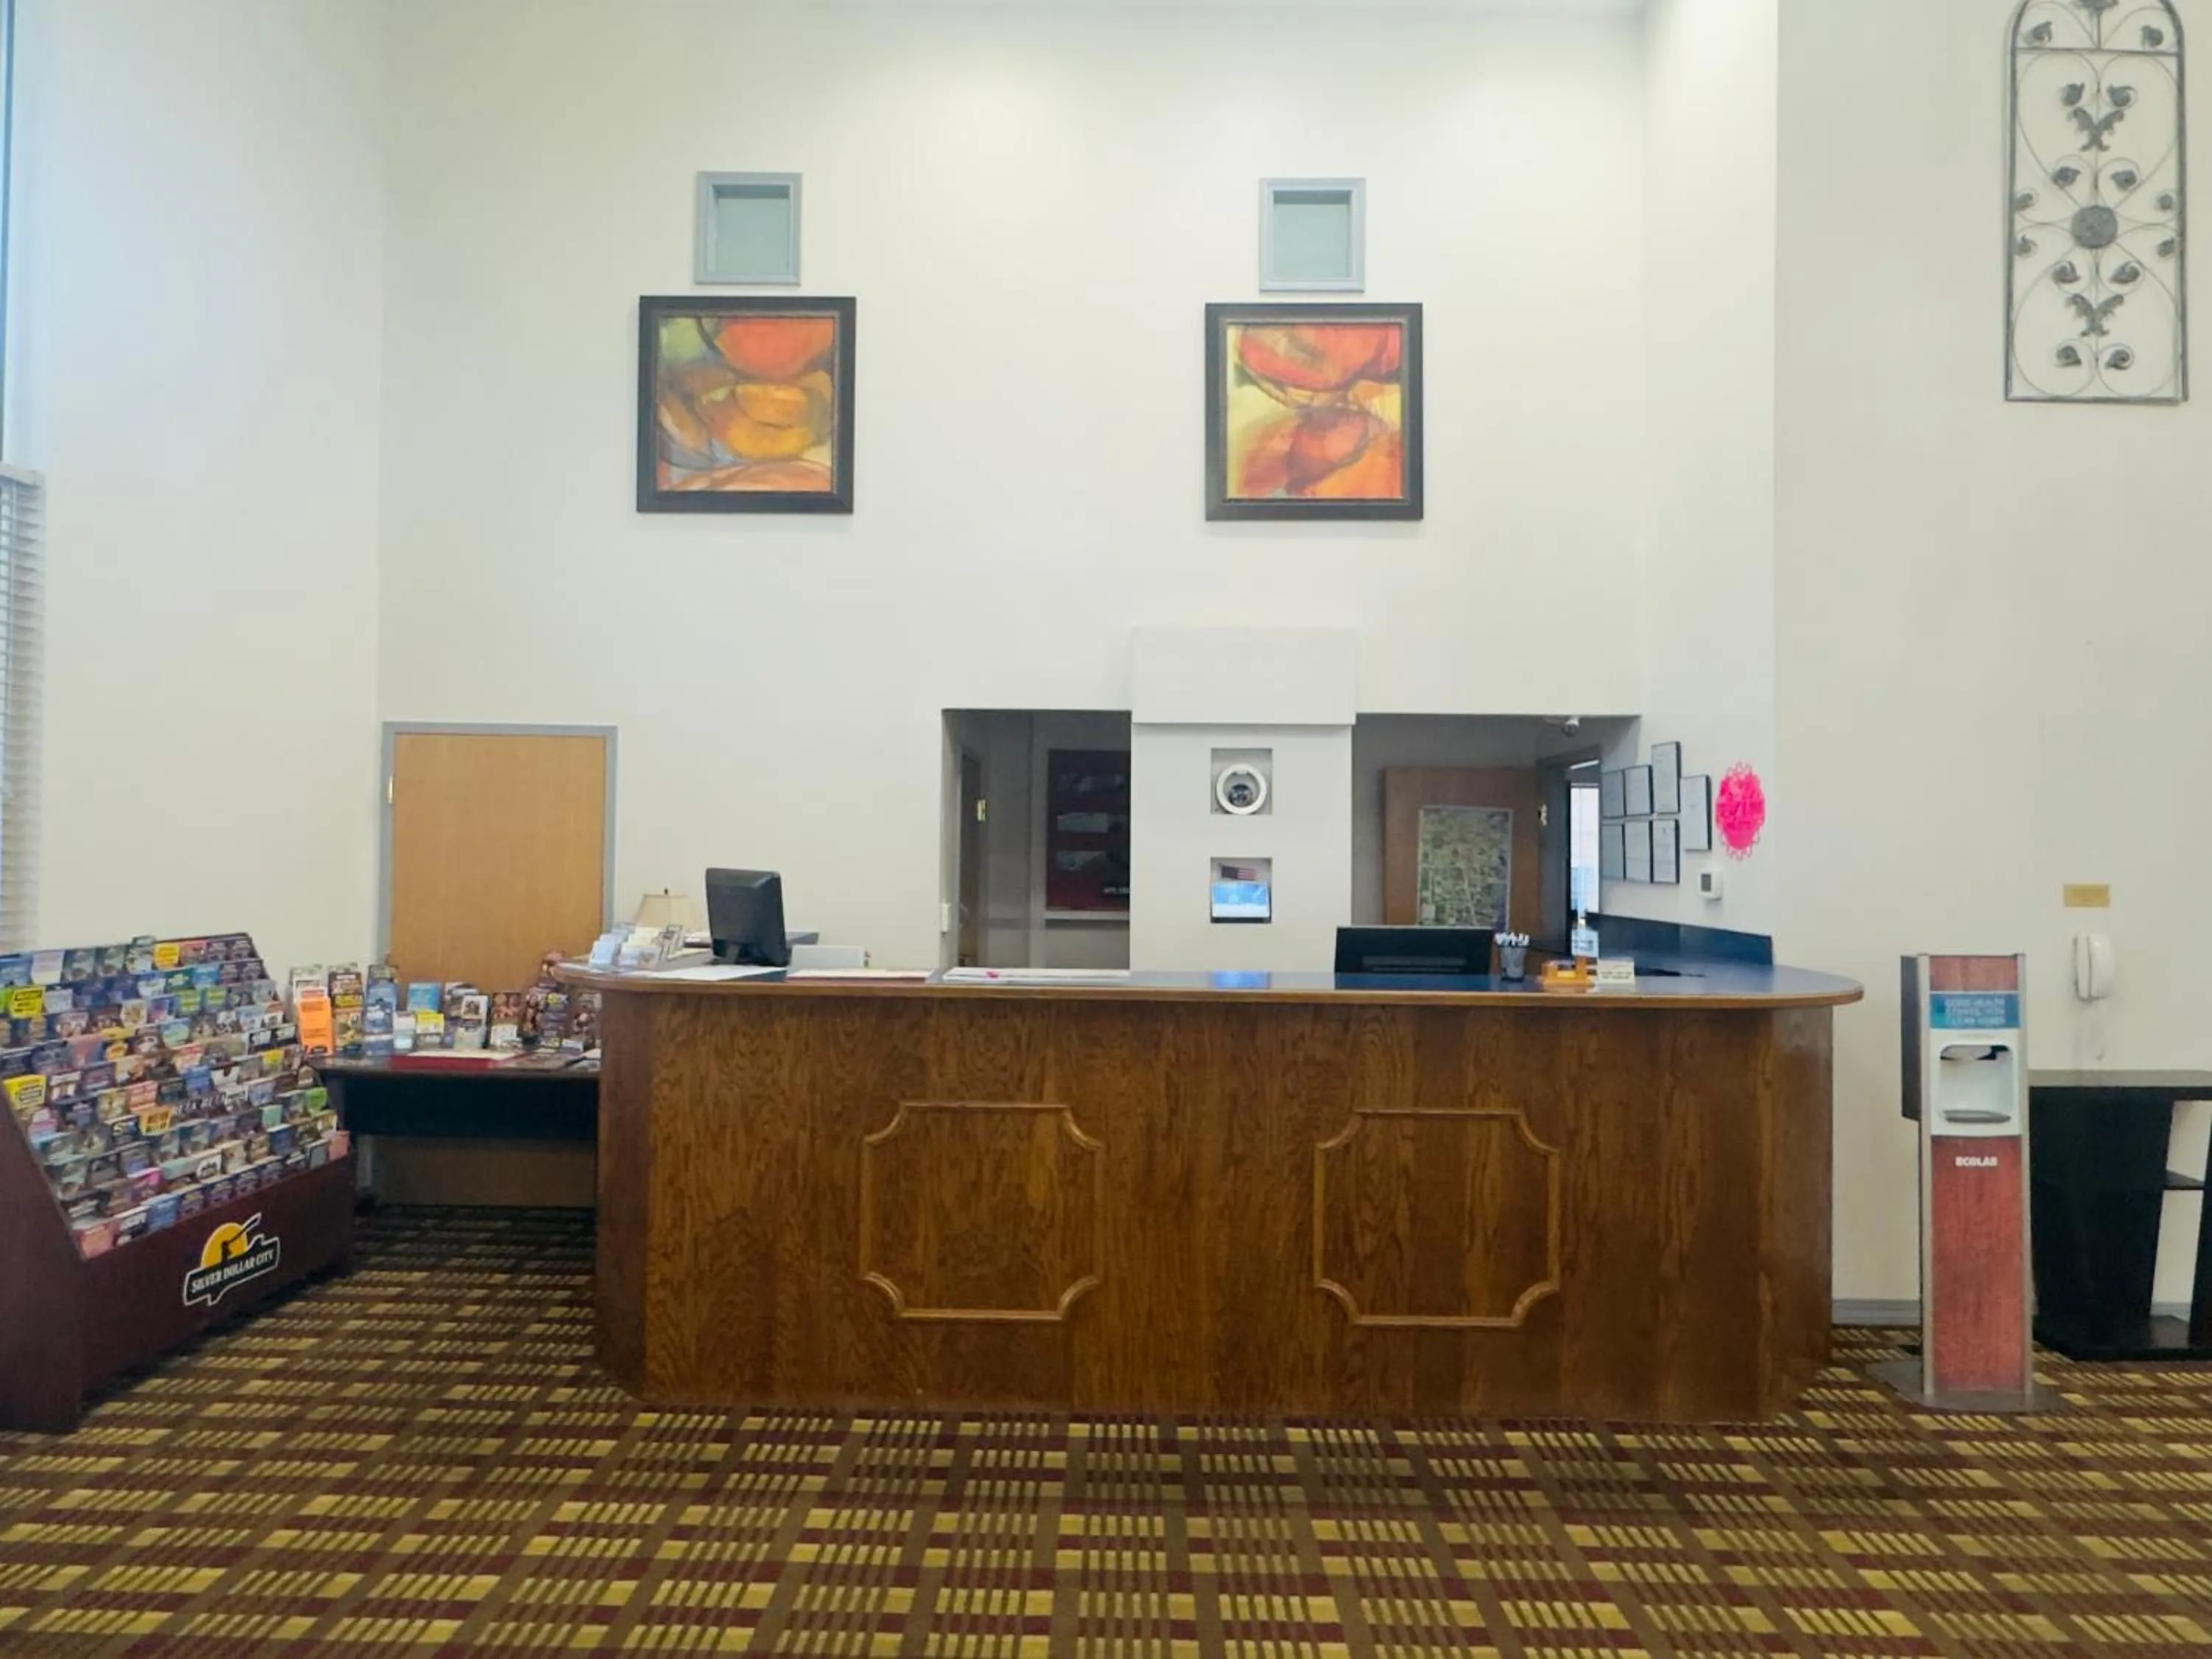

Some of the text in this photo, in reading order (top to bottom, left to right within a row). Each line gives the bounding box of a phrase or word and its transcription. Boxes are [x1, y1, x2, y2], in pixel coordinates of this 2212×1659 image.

[1955, 1155, 1998, 1166] ECOLAB
[223, 1256, 255, 1280] DOLLAR
[256, 1248, 275, 1265] CITY
